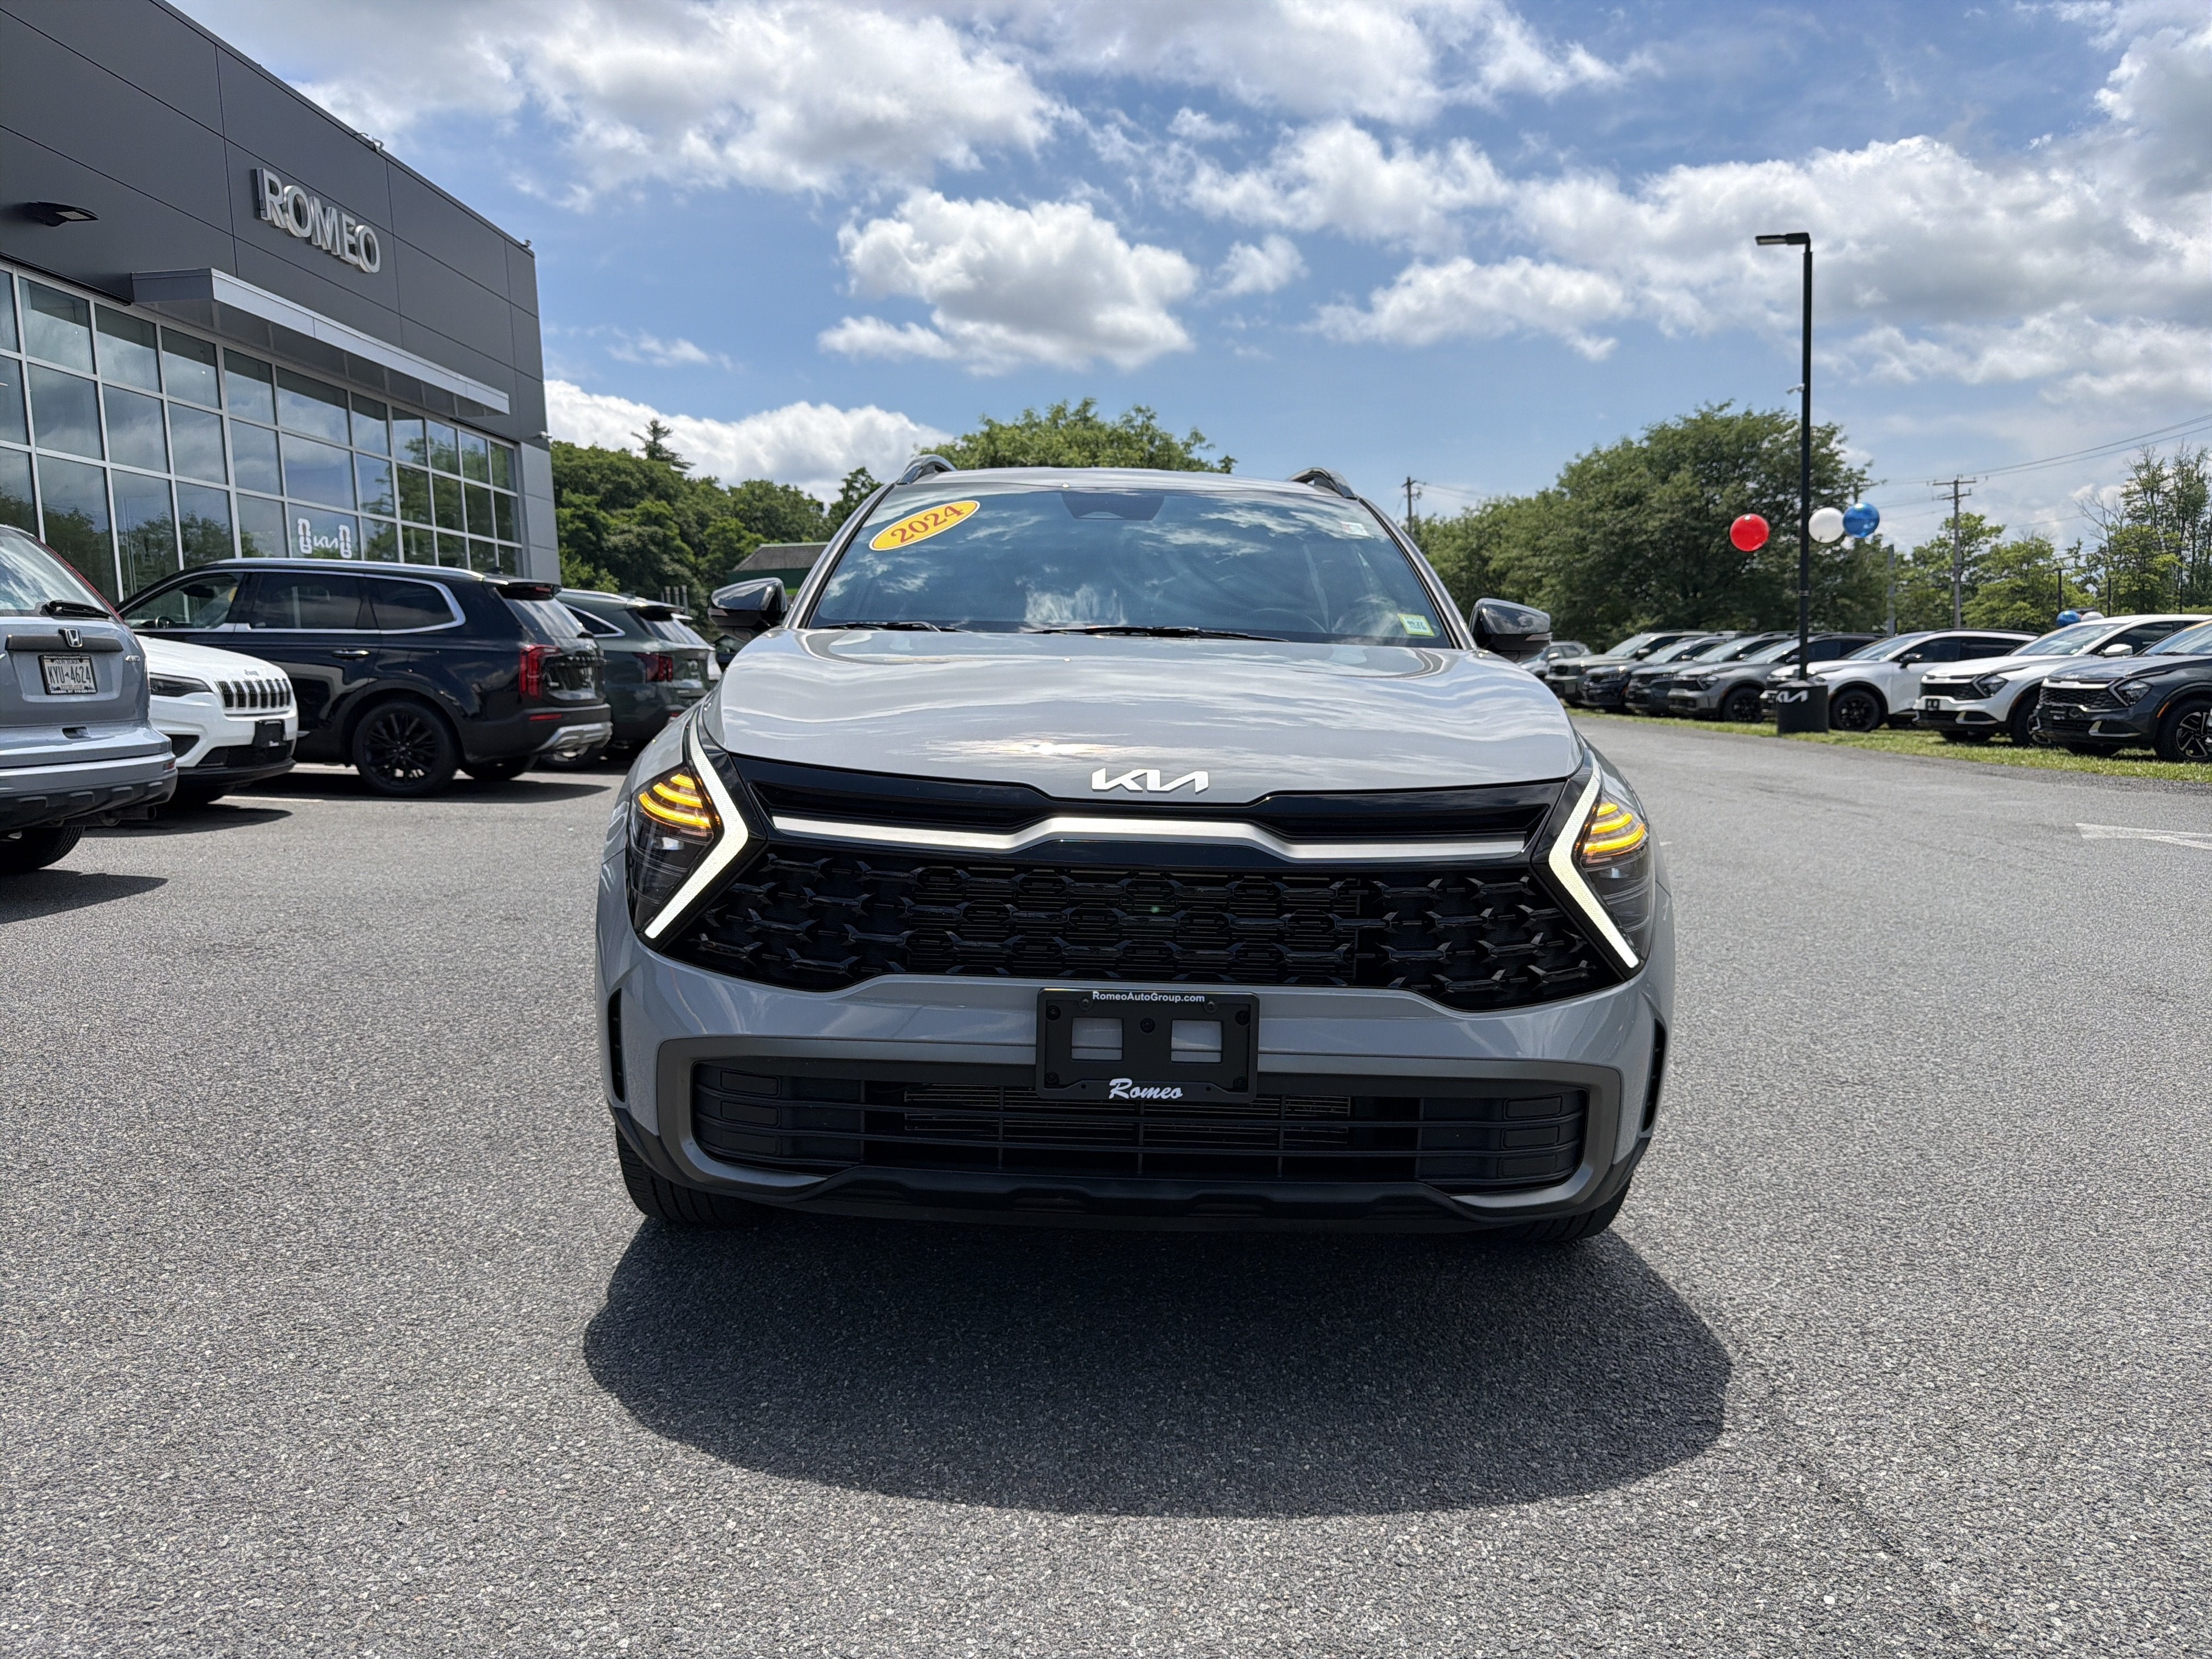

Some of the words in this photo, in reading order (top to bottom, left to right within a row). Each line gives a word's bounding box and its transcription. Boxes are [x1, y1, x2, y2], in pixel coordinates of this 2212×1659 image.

[256, 167, 381, 273] ROMEO
[891, 506, 964, 543] 2024
[1092, 768, 1209, 795] KIA
[1092, 991, 1205, 1003] RomeoAutoGroup.com
[1108, 1077, 1183, 1099] Romeo
